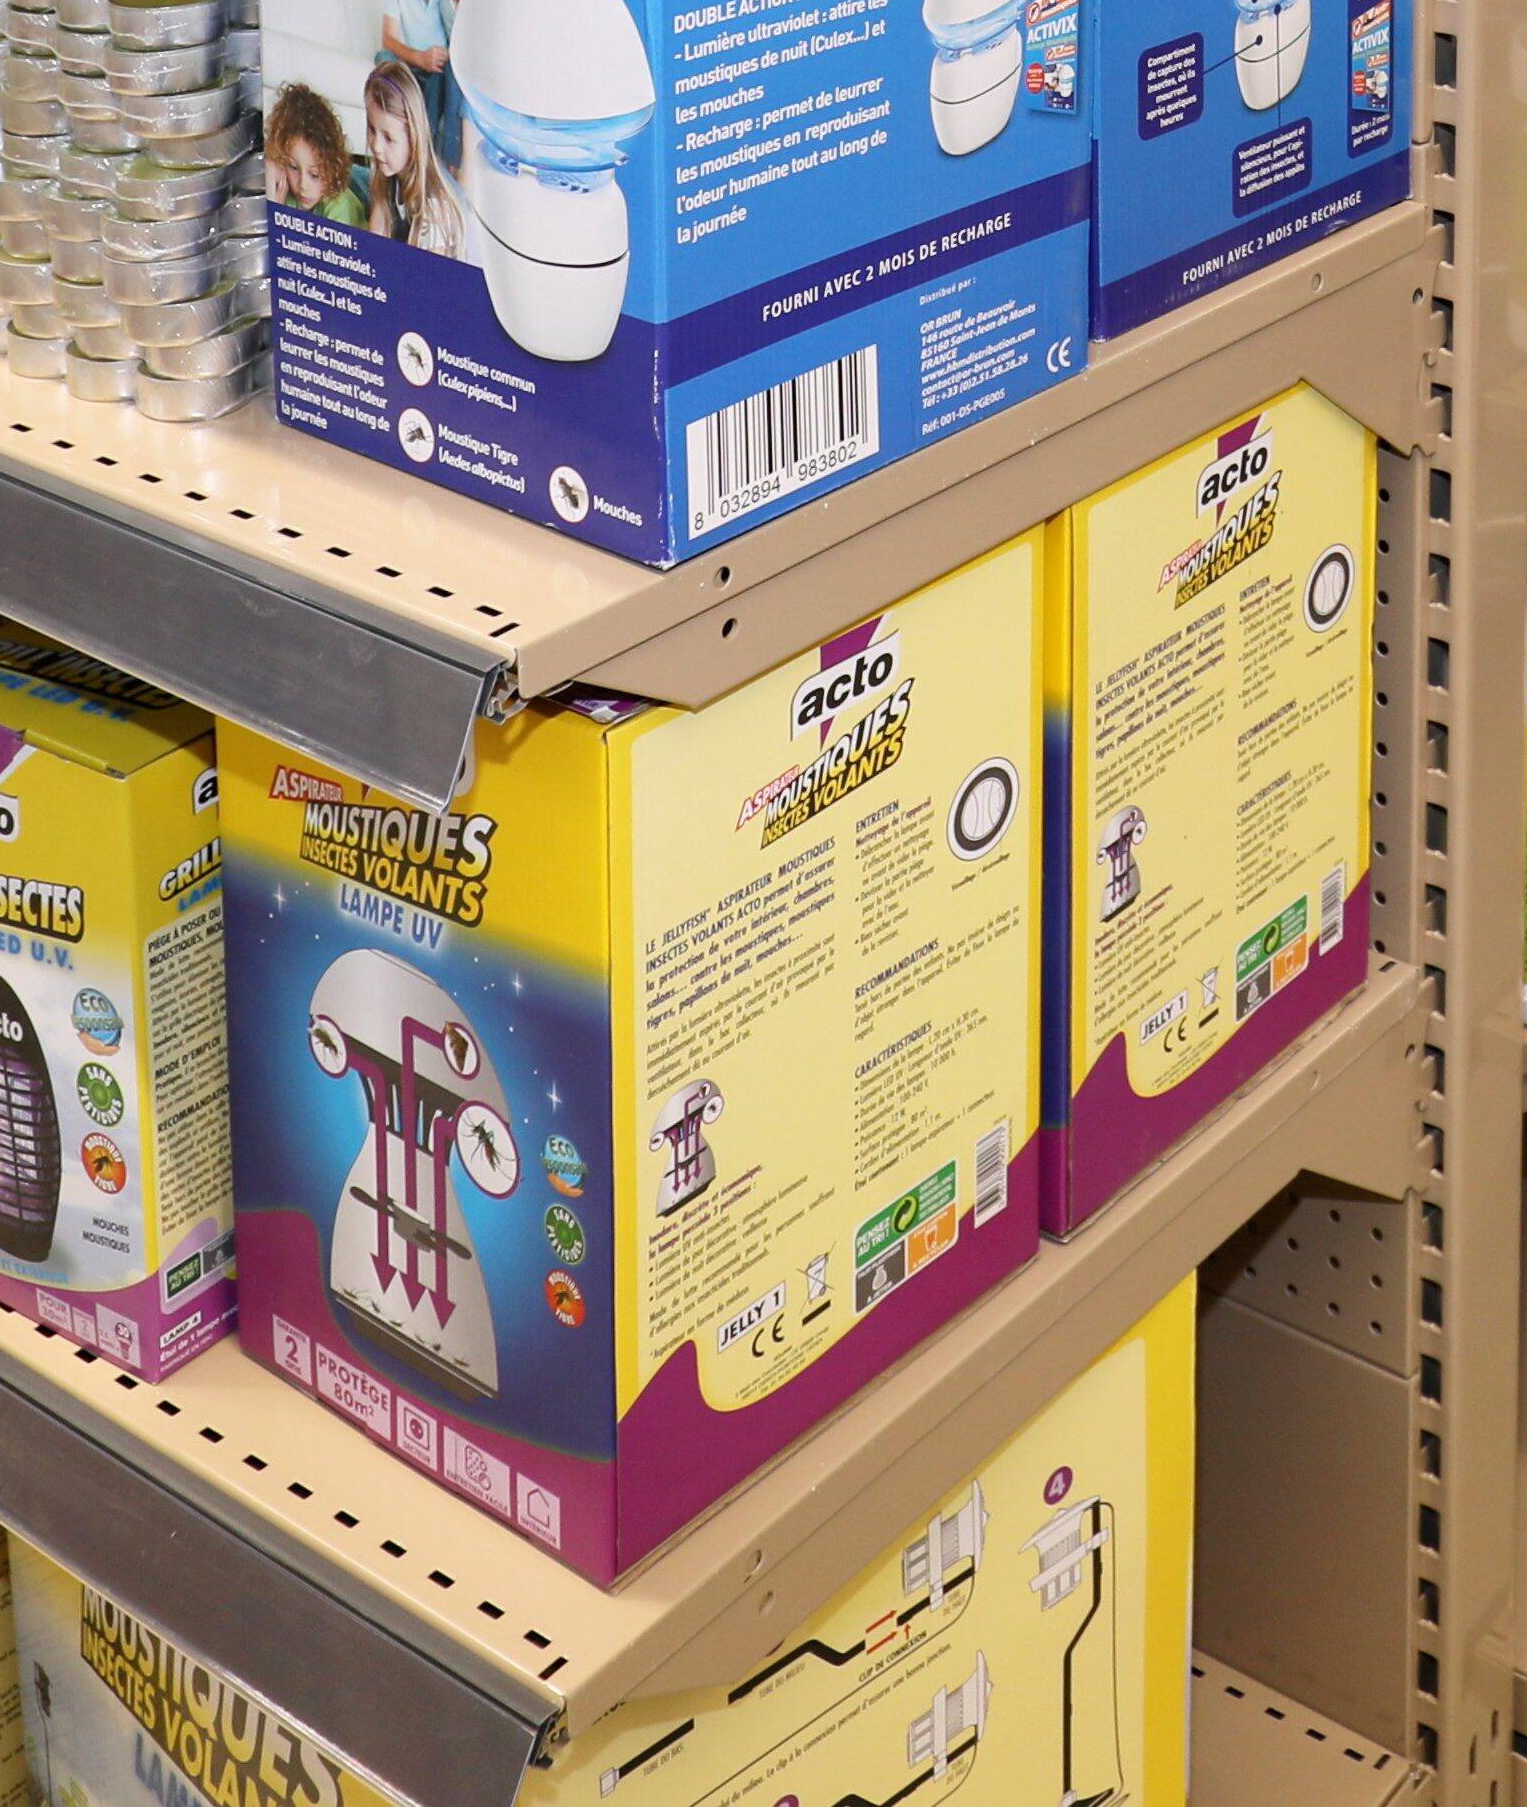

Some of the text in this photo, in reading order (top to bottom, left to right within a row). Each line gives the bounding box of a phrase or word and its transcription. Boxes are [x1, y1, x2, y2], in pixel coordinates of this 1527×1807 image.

[1027, 13, 1077, 45] ACTIVIX
[763, 214, 1012, 322] FOURNI AVEC 2 MOIS DE RECHARGE
[920, 309, 961, 333] OR BRUN
[921, 348, 957, 372] FRANCE
[437, 423, 519, 467] Moustique Tigre
[694, 443, 857, 530] 8 032894 983802
[1200, 444, 1269, 501] acto
[593, 495, 643, 528] Mouches
[797, 651, 894, 720] acto
[764, 678, 916, 828] MOUSTIQUES
[272, 767, 343, 802] ASPIRATEUR
[304, 801, 494, 878] MOUSTIQUES
[856, 801, 899, 832] ENTRETIEN
[302, 835, 483, 923] INSECTES VOLANTS
[339, 885, 443, 949] LAMPE UV
[29, 938, 75, 971] U.V.
[856, 938, 940, 997] RECOMMANDATIONS
[82, 1230, 131, 1255] MOUSTIQUES
[92, 1217, 130, 1236] MOUCHES
[318, 1352, 389, 1411] PROTÈGE
